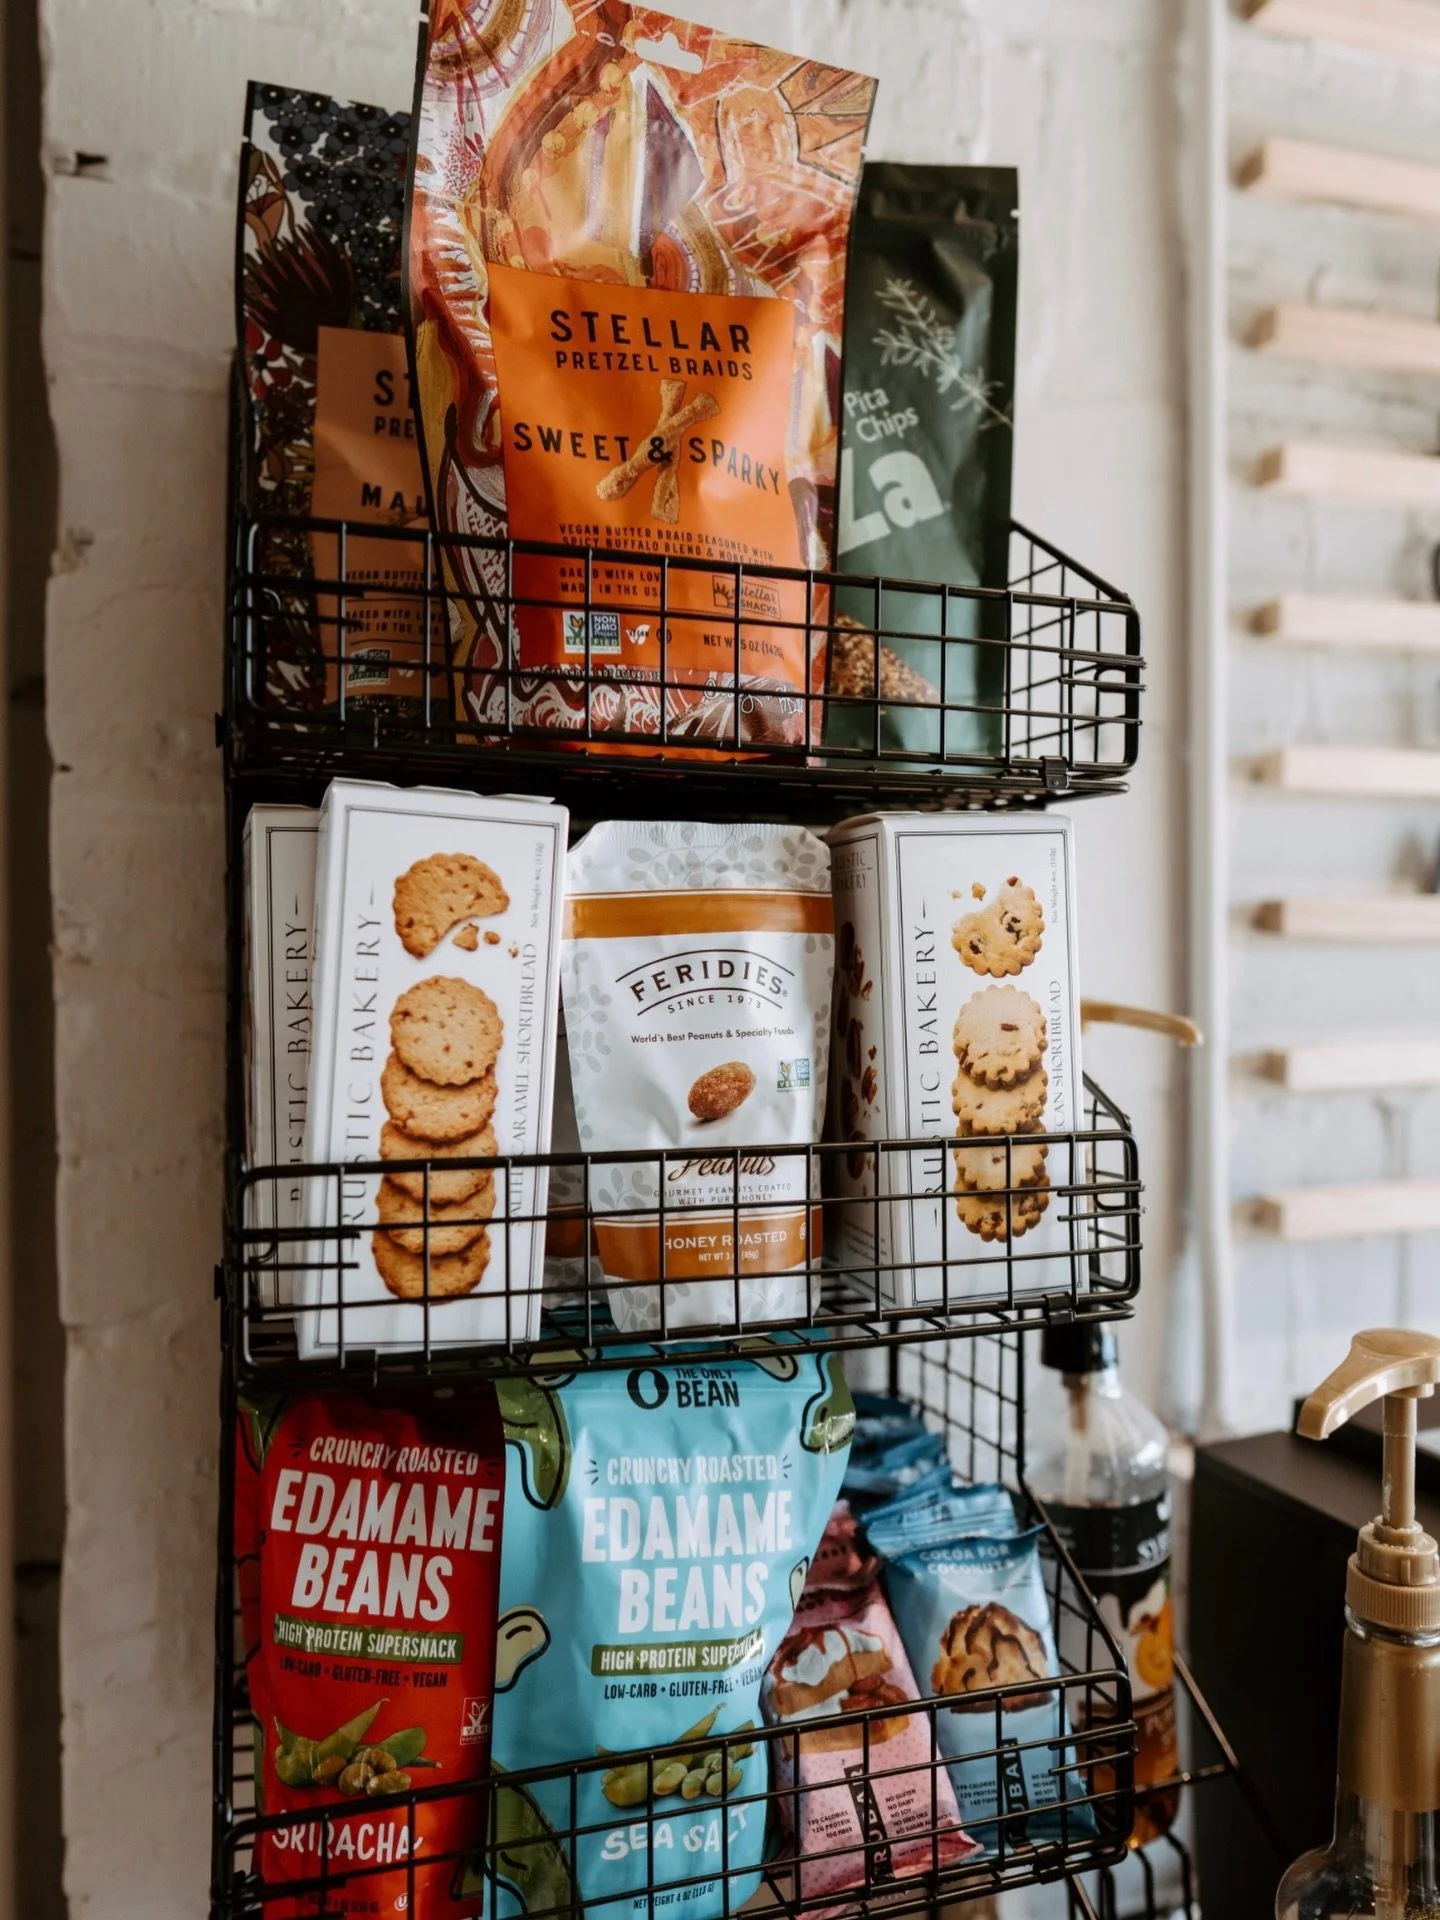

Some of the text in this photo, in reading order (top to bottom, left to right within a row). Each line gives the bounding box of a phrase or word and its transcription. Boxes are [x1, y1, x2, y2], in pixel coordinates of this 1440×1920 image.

[550, 310, 752, 354] STELLAR
[556, 351, 753, 380] PRETZEL BRAIDS
[843, 388, 890, 418] Pita
[855, 407, 920, 443] Chips
[513, 422, 781, 496] SWEET & SPARKY
[559, 524, 774, 561] VEGAN BUTTER BRAID SEASONED WITH
[562, 537, 599, 548] SPICY
[606, 539, 659, 551] BUFFALO
[664, 543, 701, 555] BLEND
[706, 548, 714, 557] &
[560, 568, 661, 583] BAKD WITH LOV
[561, 583, 586, 593] MAD
[599, 584, 612, 594] IN
[617, 584, 638, 597] THE
[594, 615, 616, 623] NON
[740, 600, 778, 616] SNACKS
[594, 623, 617, 631] GMO
[703, 634, 721, 647] NET
[740, 639, 747, 650] 5
[749, 640, 760, 653] OZ
[285, 922, 308, 1055] BAKERY
[350, 914, 381, 1062] BAKERY
[629, 959, 783, 1003] FERIDIES
[515, 943, 537, 1065] SHORTBREAD
[667, 994, 715, 1014] SINCE
[630, 1033, 665, 1044] World's
[667, 1032, 686, 1042] Best
[688, 1030, 723, 1041] Peanuts
[725, 1029, 732, 1038] &
[735, 1027, 772, 1039] Specialty
[1049, 980, 1064, 1087] SHORTBREAD
[914, 925, 943, 1198] RUTIC BAKERY
[711, 1195, 733, 1203] PUR
[741, 1193, 773, 1202] HONEY
[758, 1182, 792, 1192] COATED
[665, 1235, 718, 1250] HONEY
[673, 1367, 733, 1380] THE ONLY
[676, 1379, 740, 1408] BEAN
[309, 1436, 479, 1476] CRUNCHY ROASTED
[608, 1454, 778, 1486] CRUNCHY ROASTED
[270, 1468, 501, 1553] EDAMAME
[581, 1490, 793, 1563] EDAMAME
[919, 1544, 1010, 1561] COCOA FOR
[291, 1542, 453, 1622] BEANS
[618, 1562, 769, 1634] BEANS
[278, 1620, 456, 1659] HIGH PROTEIN SUPERSNACK
[280, 1655, 448, 1688] LOW-CARB GLUTEN-FREE VEGAN
[600, 1651, 634, 1671] HIGH
[640, 1647, 697, 1669] PROTEIN
[604, 1667, 763, 1700] LOW-CARB GLUTEN-FREE VEGAN
[968, 1780, 996, 1790] CALORIE
[820, 1810, 849, 1823] CALORIES
[825, 1818, 851, 1831] PROTEIN
[600, 1803, 749, 1861] SEA SAT
[633, 1899, 648, 1910] NET
[649, 1893, 675, 1907] EIGHT
